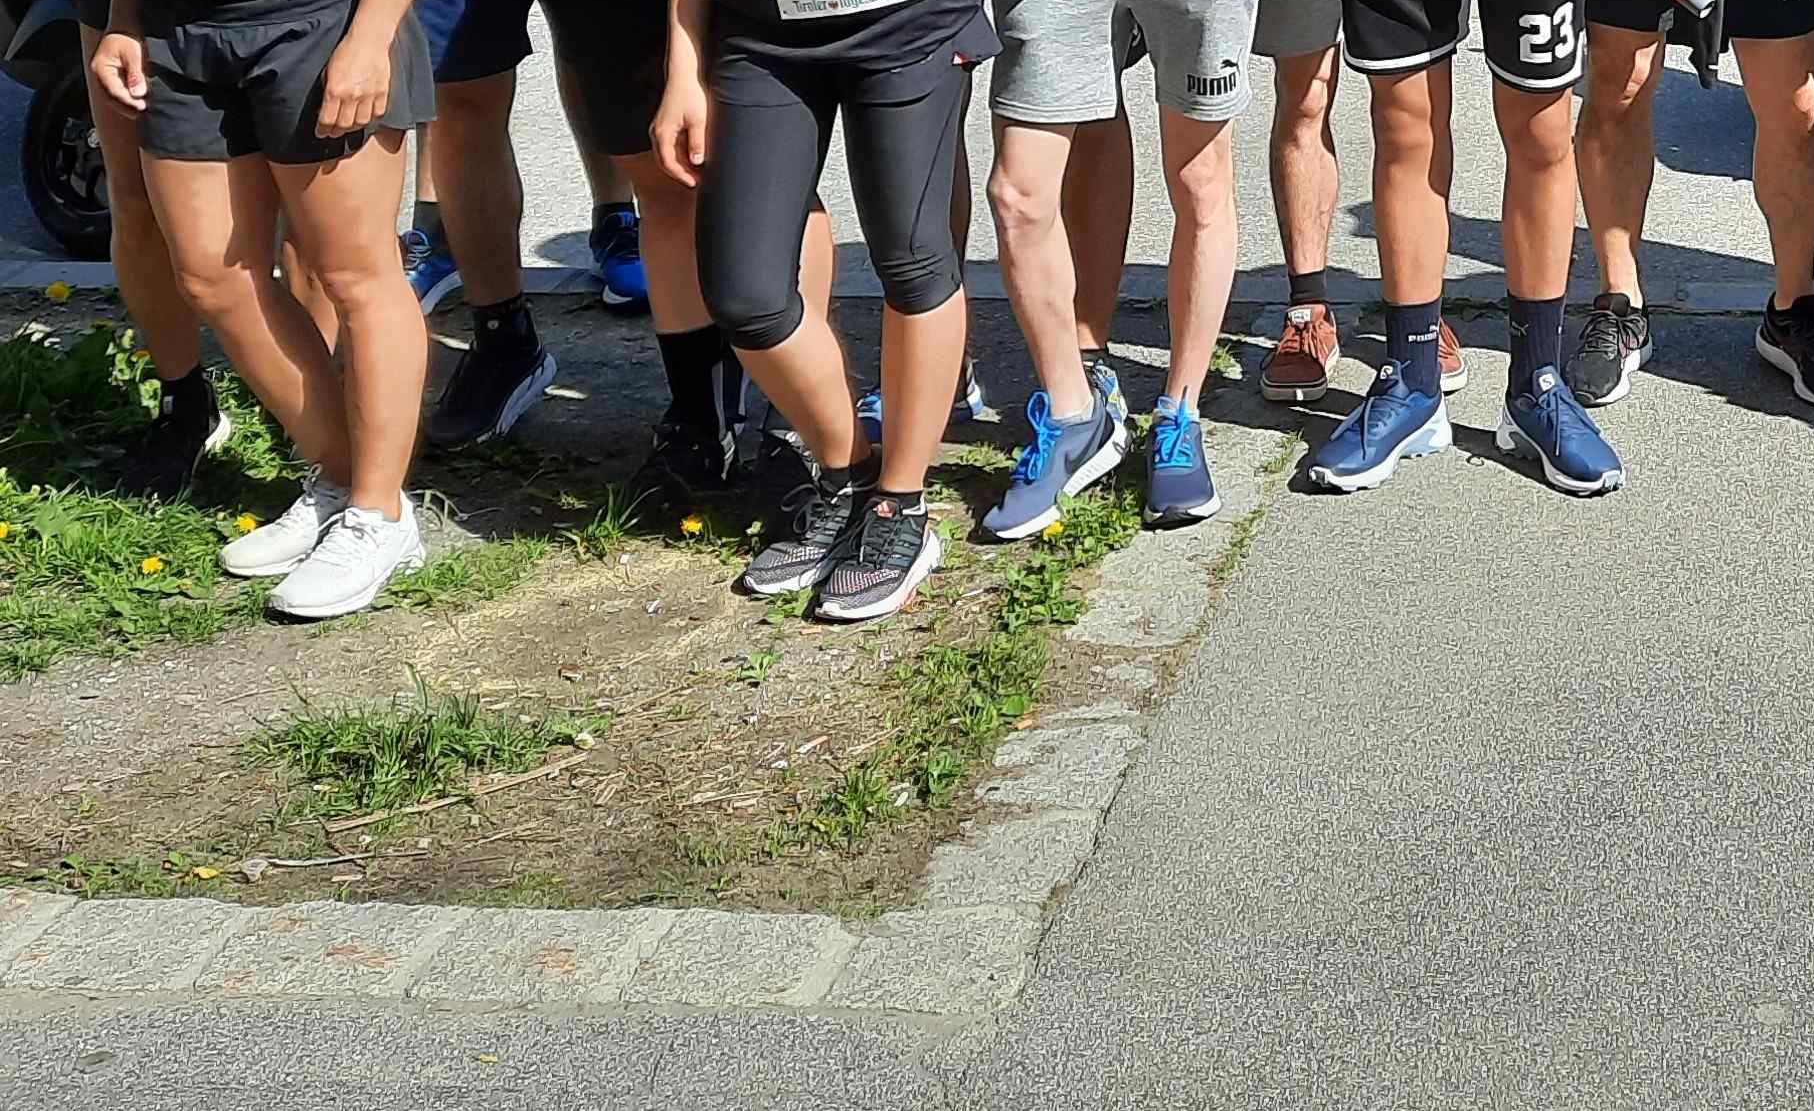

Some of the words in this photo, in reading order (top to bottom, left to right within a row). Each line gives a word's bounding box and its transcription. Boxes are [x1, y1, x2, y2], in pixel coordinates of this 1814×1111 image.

[792, 0, 828, 14] Tiroler
[1518, 1, 1575, 64] 23
[1186, 71, 1237, 96] PUMA
